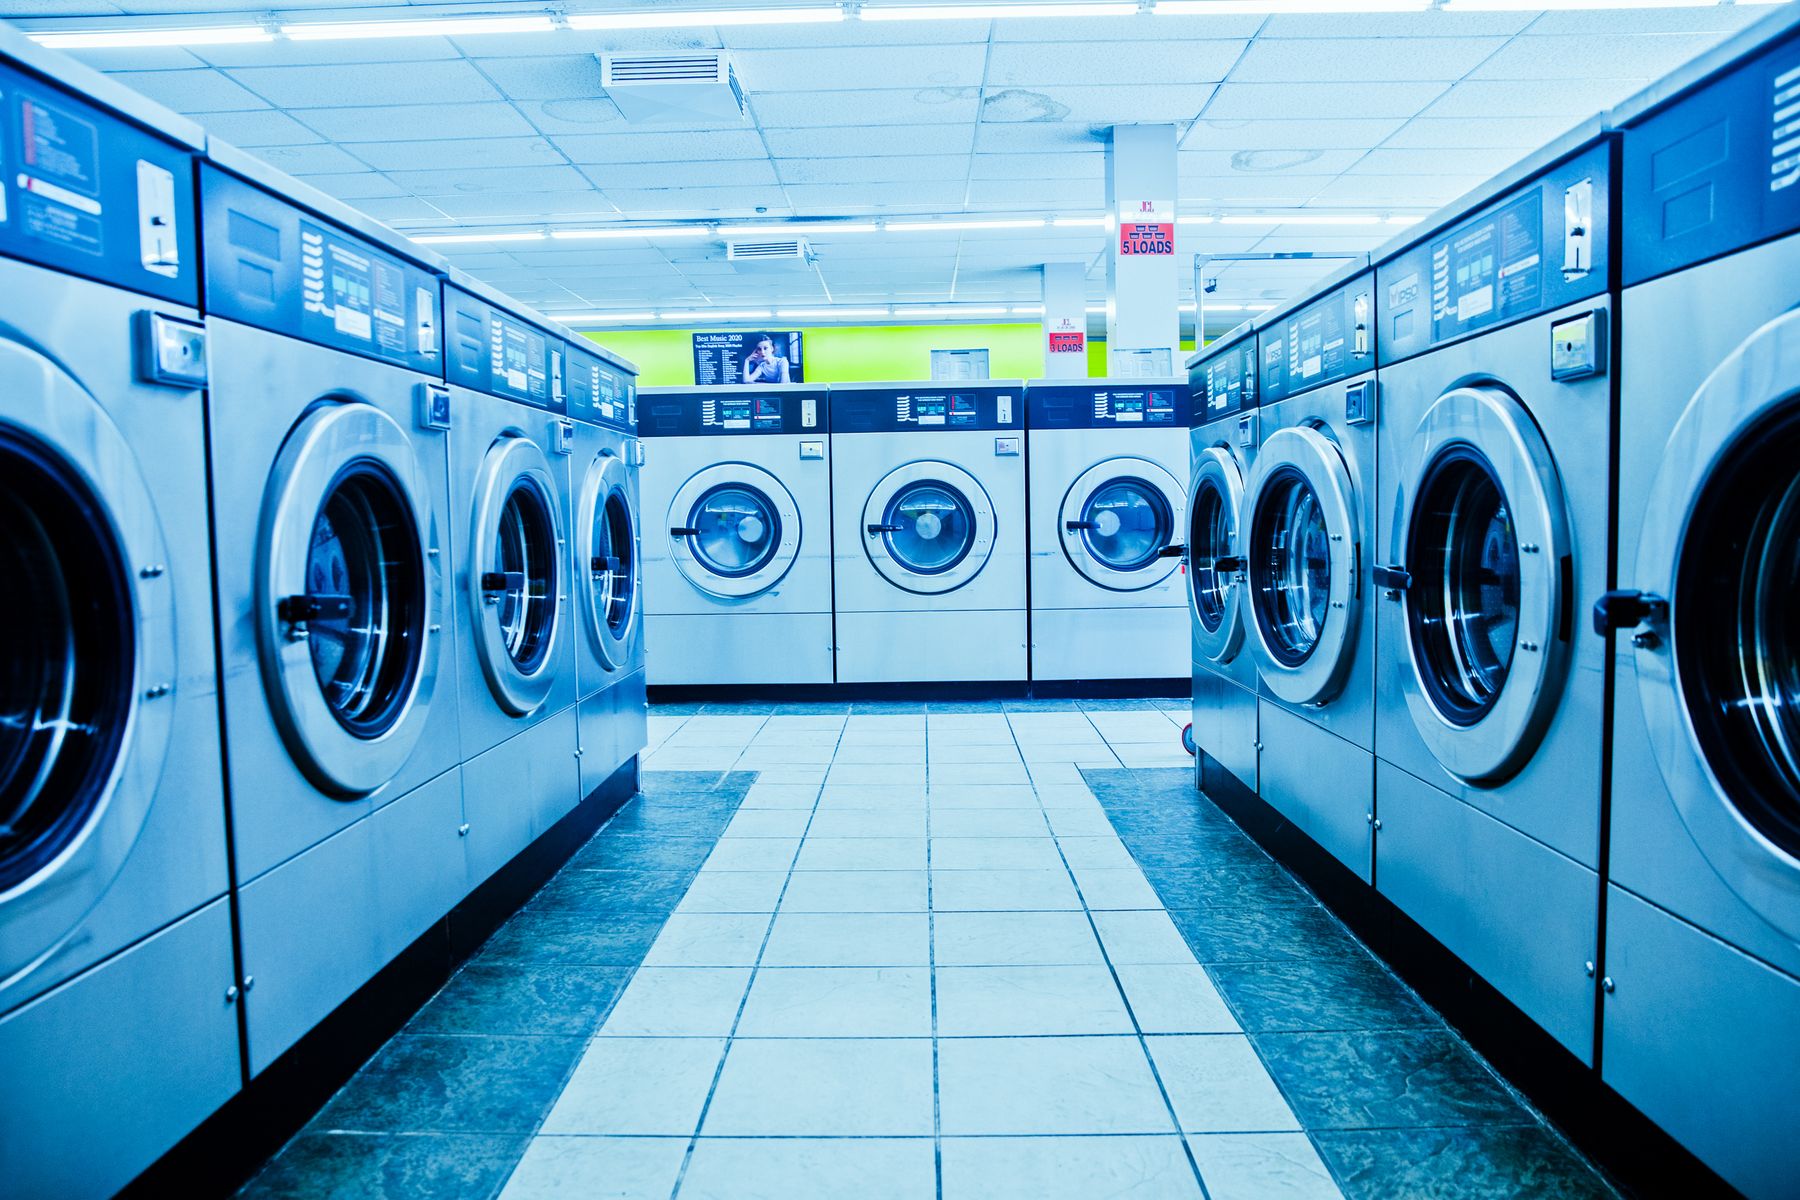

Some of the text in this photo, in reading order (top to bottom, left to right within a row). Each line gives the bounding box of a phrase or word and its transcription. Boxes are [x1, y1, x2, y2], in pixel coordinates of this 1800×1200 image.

[1123, 240, 1172, 254] 5 LOADS
[709, 334, 727, 342] Music
[1050, 343, 1082, 352] 3 LOADS
